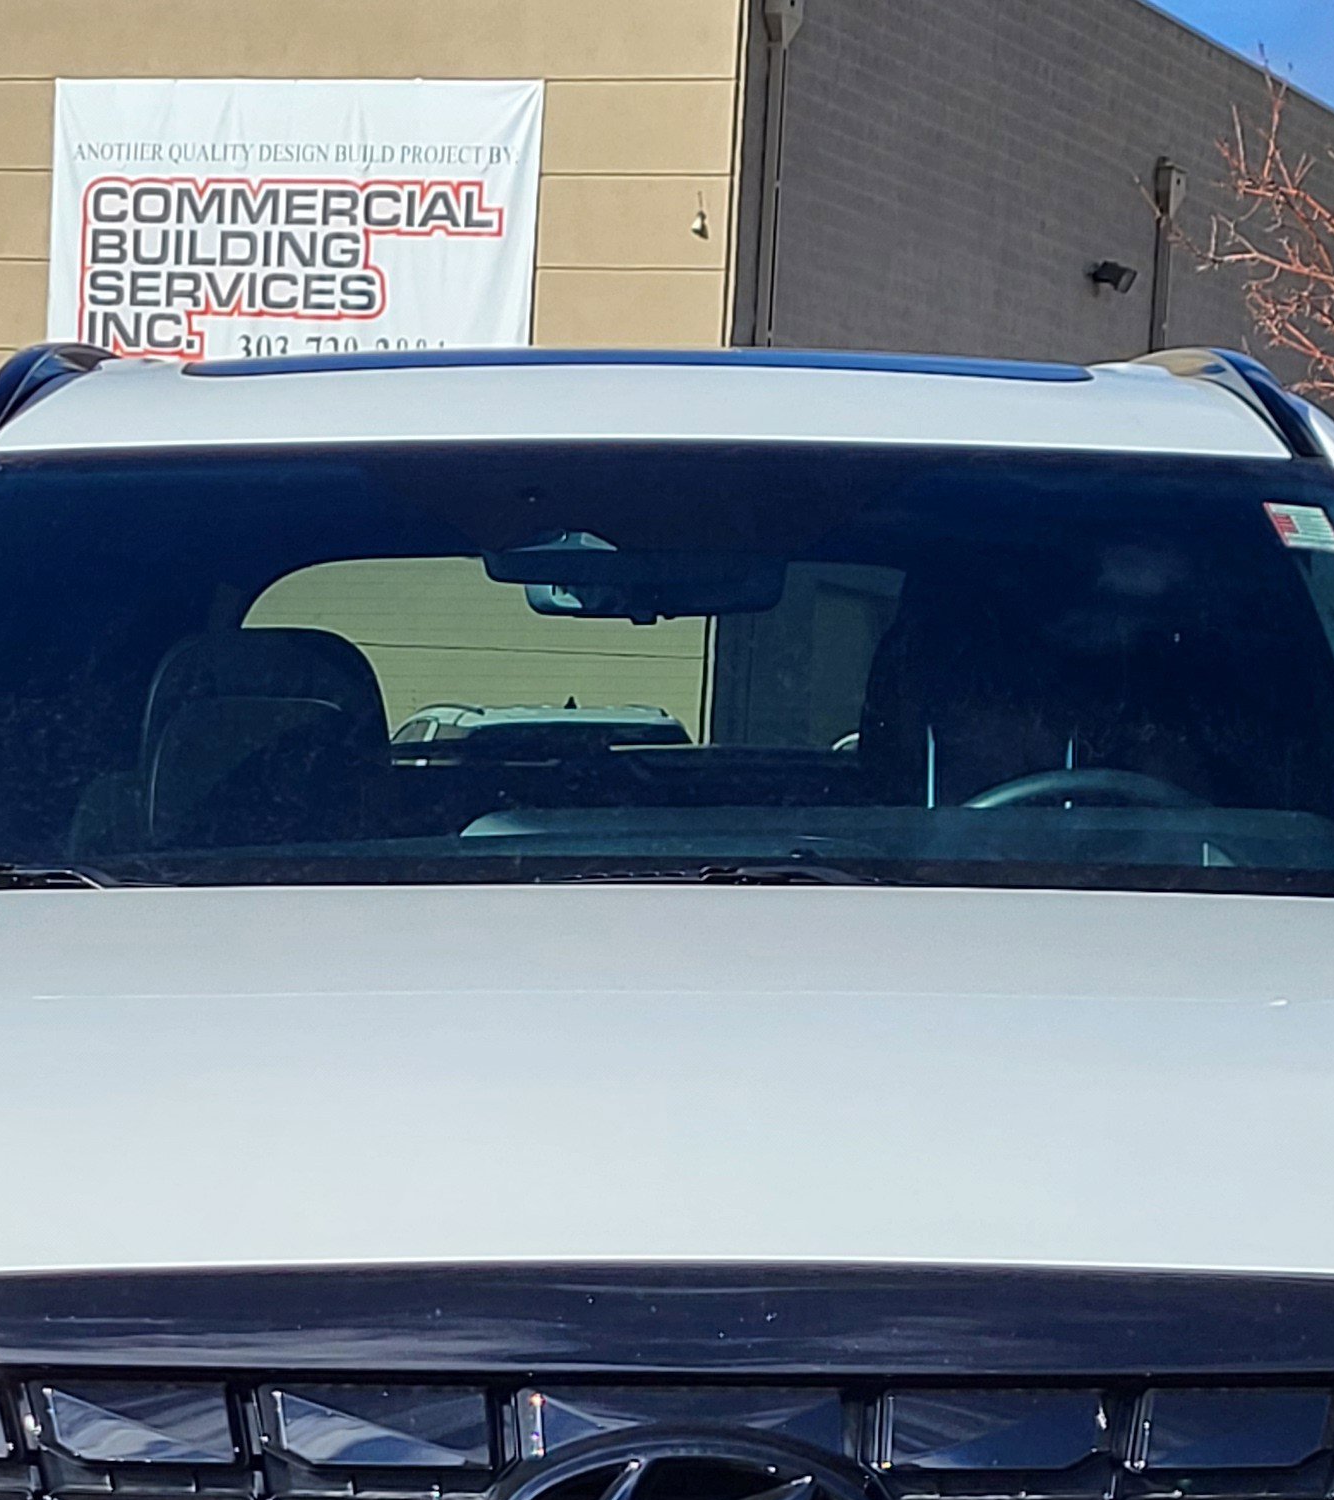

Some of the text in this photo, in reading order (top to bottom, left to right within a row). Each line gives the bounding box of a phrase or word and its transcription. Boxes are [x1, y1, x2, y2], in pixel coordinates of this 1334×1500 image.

[74, 142, 163, 162] ANOTHER
[168, 142, 254, 164] QUALITY
[258, 143, 328, 163] DESIGN
[334, 144, 395, 164] BUILD
[400, 144, 484, 166] PROJECT
[92, 187, 494, 229] COMMERCIAL
[90, 228, 361, 268] BUILDING
[88, 270, 377, 311] SERVICES
[87, 311, 196, 350] INC.
